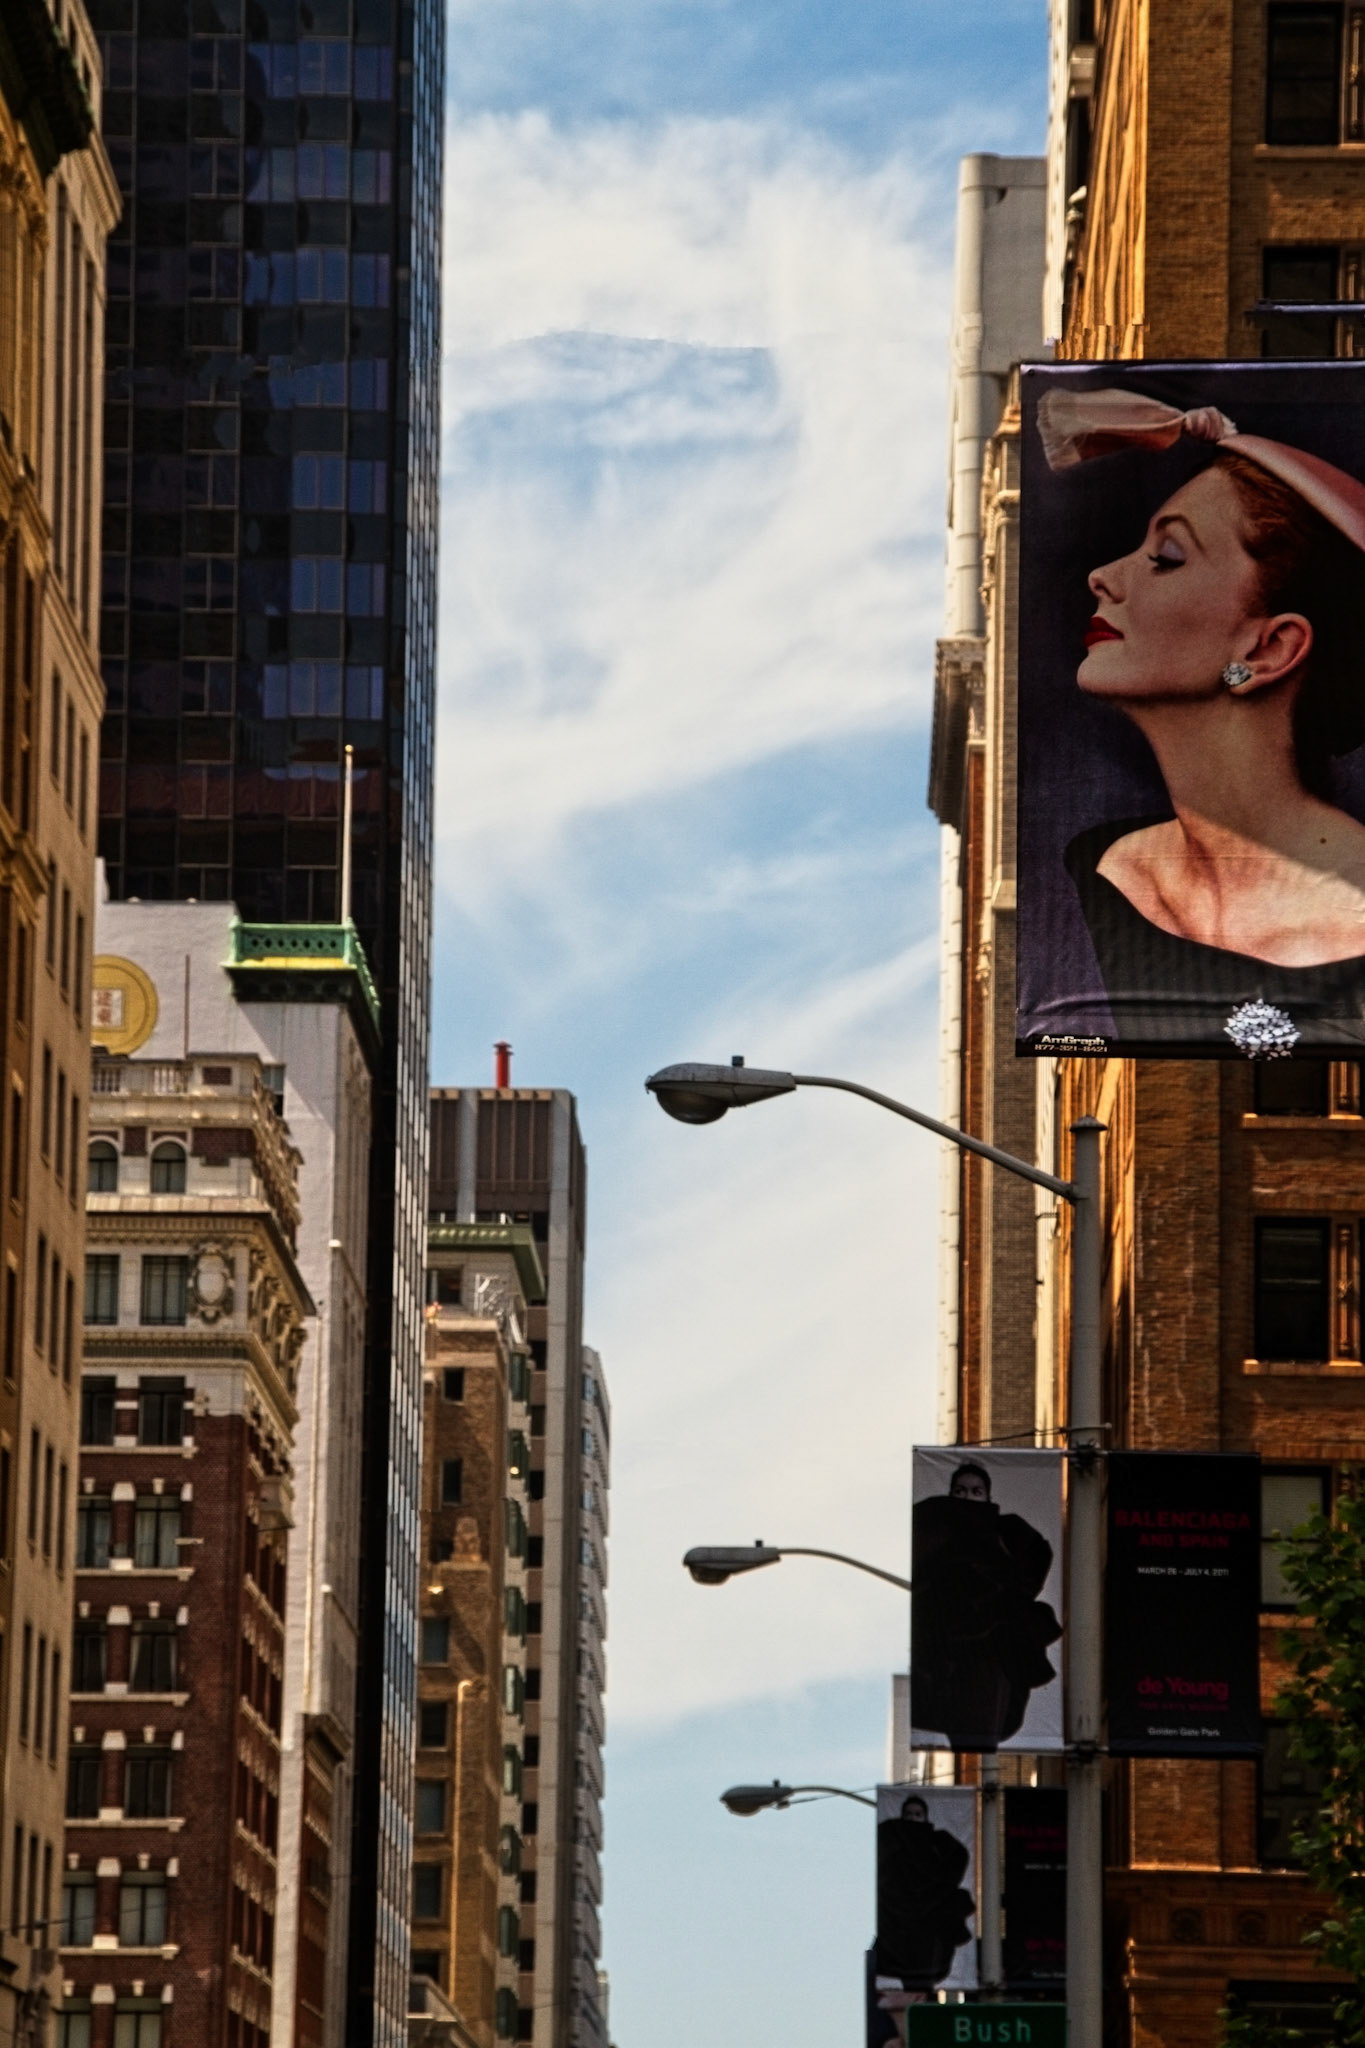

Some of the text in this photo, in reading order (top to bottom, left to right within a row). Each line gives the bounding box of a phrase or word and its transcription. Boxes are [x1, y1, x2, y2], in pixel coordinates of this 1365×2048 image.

[1041, 1035, 1105, 1046] AmGraph
[1115, 1511, 1250, 1529] BALENCIAGA
[1139, 1534, 1230, 1549] AND SPAIN
[1137, 1567, 1166, 1576] MARCH
[1137, 1677, 1230, 1703] de Young
[1147, 1727, 1221, 1738] Golden Gate Park
[955, 2017, 1031, 2043] Bush
